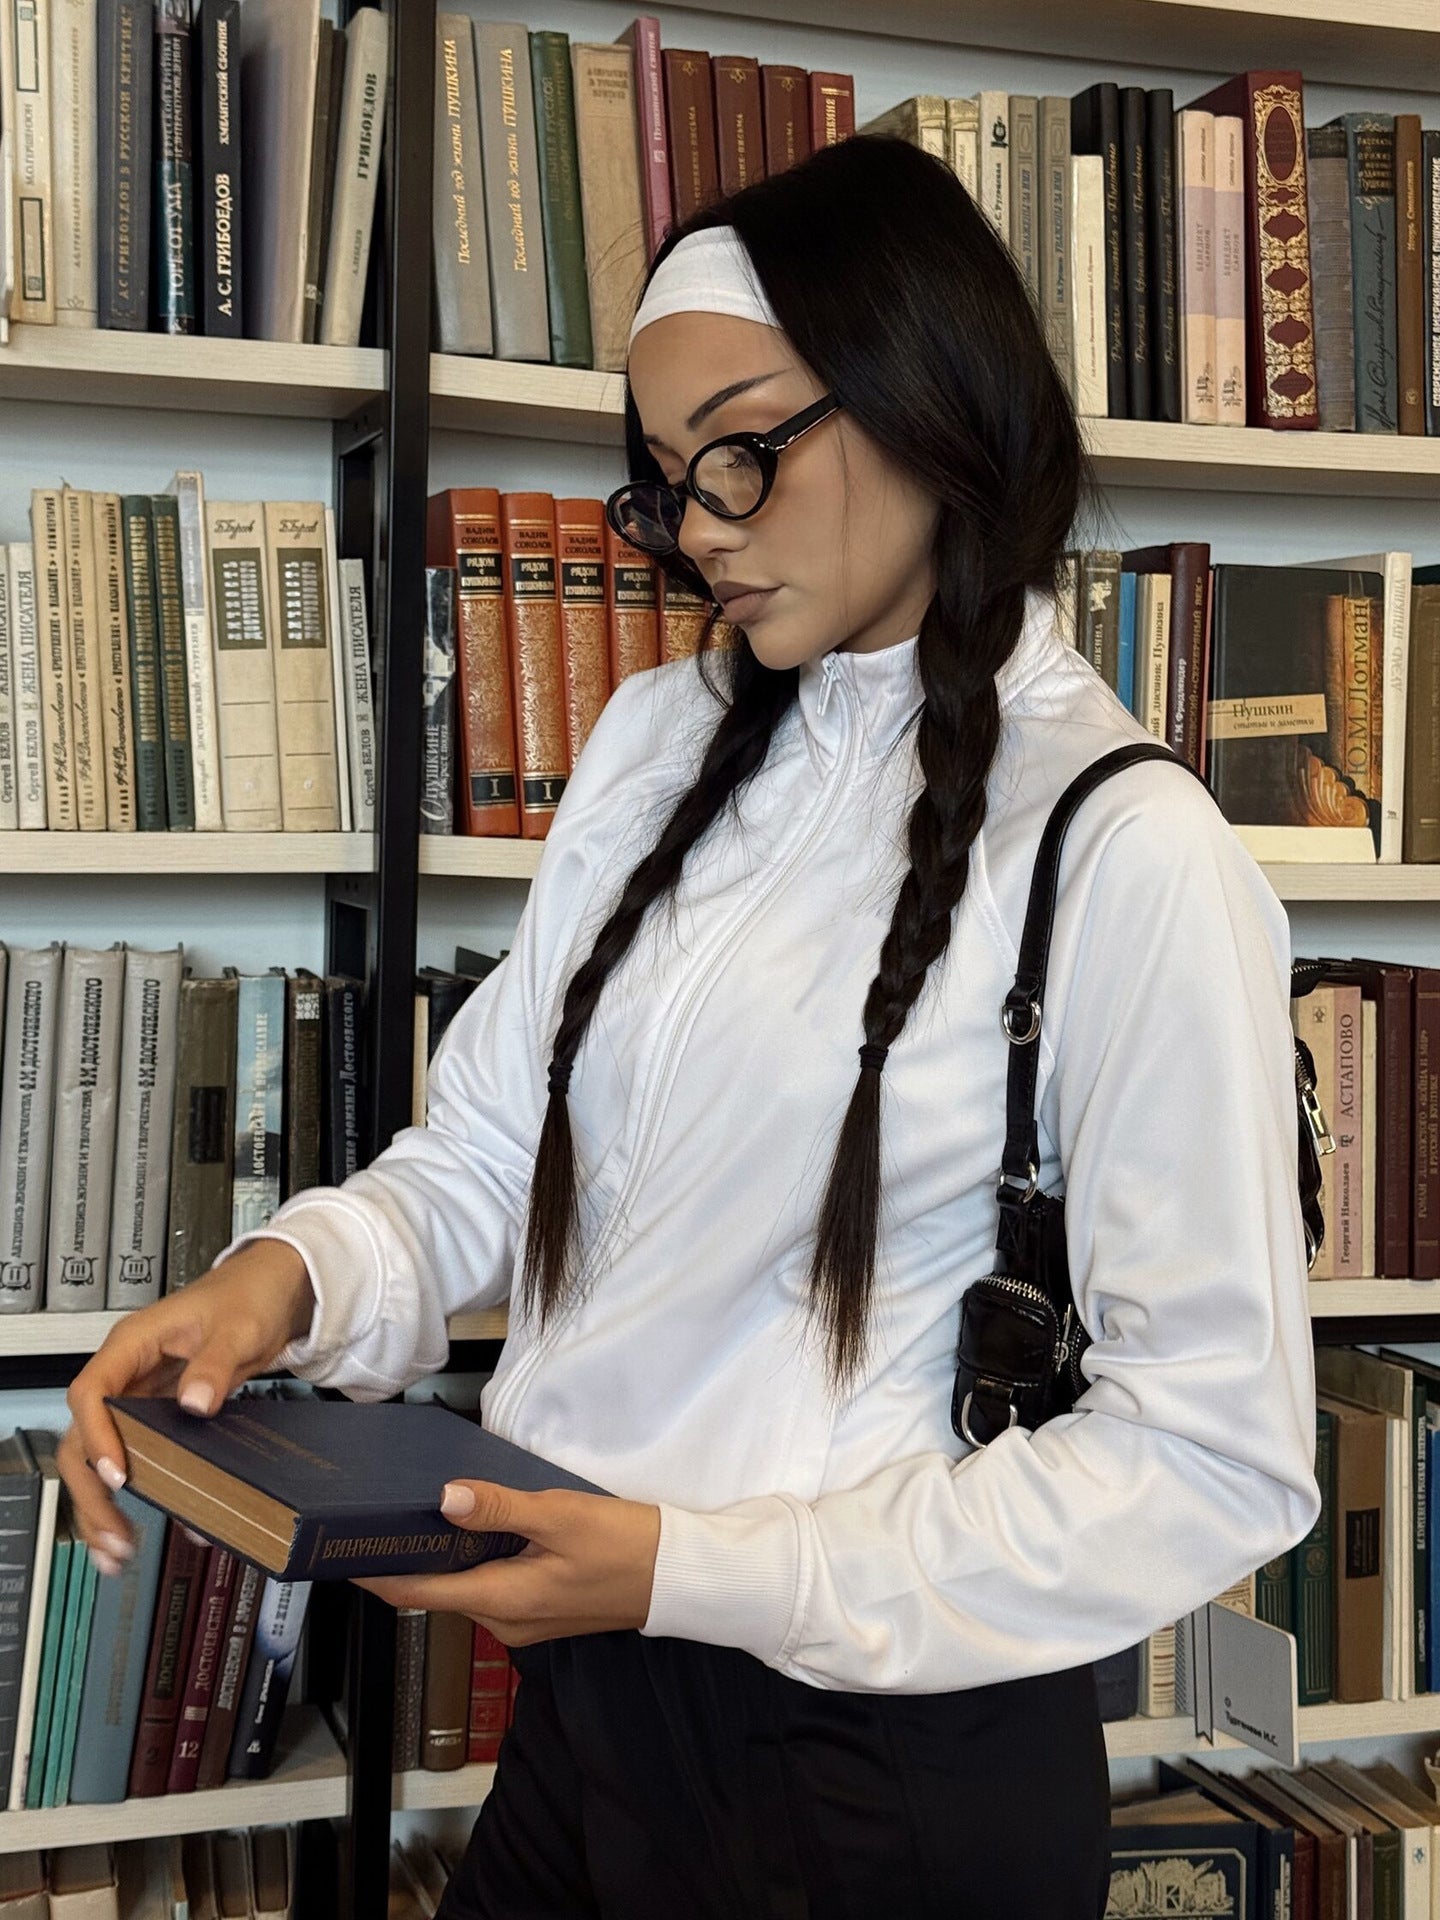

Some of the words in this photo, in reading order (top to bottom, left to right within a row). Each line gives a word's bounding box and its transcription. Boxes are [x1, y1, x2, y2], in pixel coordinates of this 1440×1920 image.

[215, 19, 229, 70] СБОРНИК
[444, 39, 462, 118] ПУШКИНА
[500, 48, 517, 127] ПУШКИНА
[119, 91, 131, 161] РУССКОЙ
[356, 73, 378, 181] ГРИБОЕДОВ
[542, 77, 557, 133] РУССКОЙ
[649, 72, 663, 141] Пушкинский
[451, 123, 463, 167] жизни
[506, 132, 519, 175] жизни
[451, 171, 465, 190] год
[506, 179, 520, 199] год
[118, 180, 130, 274] ГРИБОЕДОВ
[215, 173, 232, 276] ГРИБОЕДОВ
[453, 194, 471, 264] Последний
[508, 203, 527, 272] Последний
[217, 278, 232, 296] С.
[217, 299, 232, 316] А.
[461, 536, 500, 545] СОКОЛОВ
[465, 527, 496, 535] ВАДИМ
[514, 540, 553, 549] СОКОЛОВ
[519, 531, 549, 540] ВАДИМ
[565, 546, 602, 555] СОКОЛОВ
[569, 536, 598, 545] ВАДИМ
[466, 557, 495, 568] РЯДОМ
[520, 562, 549, 573] РЯДОМ
[570, 567, 598, 577] РЯДОМ
[18, 570, 34, 646] ПИСАТЕЛЯ
[349, 585, 366, 658] ПИСАТЕЛЯ
[1152, 601, 1166, 659] Пушкина
[22, 650, 36, 695] ЖЕНА
[354, 662, 369, 705] ЖЕНА
[1232, 703, 1295, 722] Пушкин
[25, 720, 38, 758] БЕЛОВ
[360, 728, 373, 765] БЕЛОВ
[425, 723, 440, 799] ПУШКИНЕ
[27, 762, 41, 802] Сергей
[362, 768, 375, 807] Сергей
[21, 980, 42, 1070] ДОСТОЕВСКОГО
[83, 977, 103, 1067] ДОСТОЕВСКОГО
[141, 978, 160, 1067] ДОСТОЕВСКОГО
[339, 991, 358, 1083] Достоевского
[1339, 1013, 1355, 1118] АСТАПОВО
[17, 1093, 32, 1154] ТВОРЧЕСТВА
[79, 1090, 93, 1151] ТВОРЧЕСТВА
[137, 1090, 151, 1151] ТВОРЧЕСТВА
[342, 1084, 360, 1138] романы
[14, 1166, 27, 1205] ЖИЗНИ
[76, 1162, 89, 1201] ЖИЗНИ
[1339, 1162, 1351, 1217] Николаев
[11, 1206, 24, 1259] ЛЕТОПИСЬ
[73, 1202, 87, 1254] ЛЕТОПИСЬ
[131, 1201, 145, 1253] ЛЕТОПИСЬ
[1340, 1219, 1352, 1264] Георгий
[322, 1534, 453, 1559] ВОСПОМИНАНИЯ
[157, 1580, 187, 1691] ДОСТОЕВСКИЙ
[194, 1596, 226, 1691] ДОСТОЕВСКИЙ
[217, 1636, 245, 1711] ДОСТОЕВСКИЙ
[179, 1740, 198, 1759] 12
